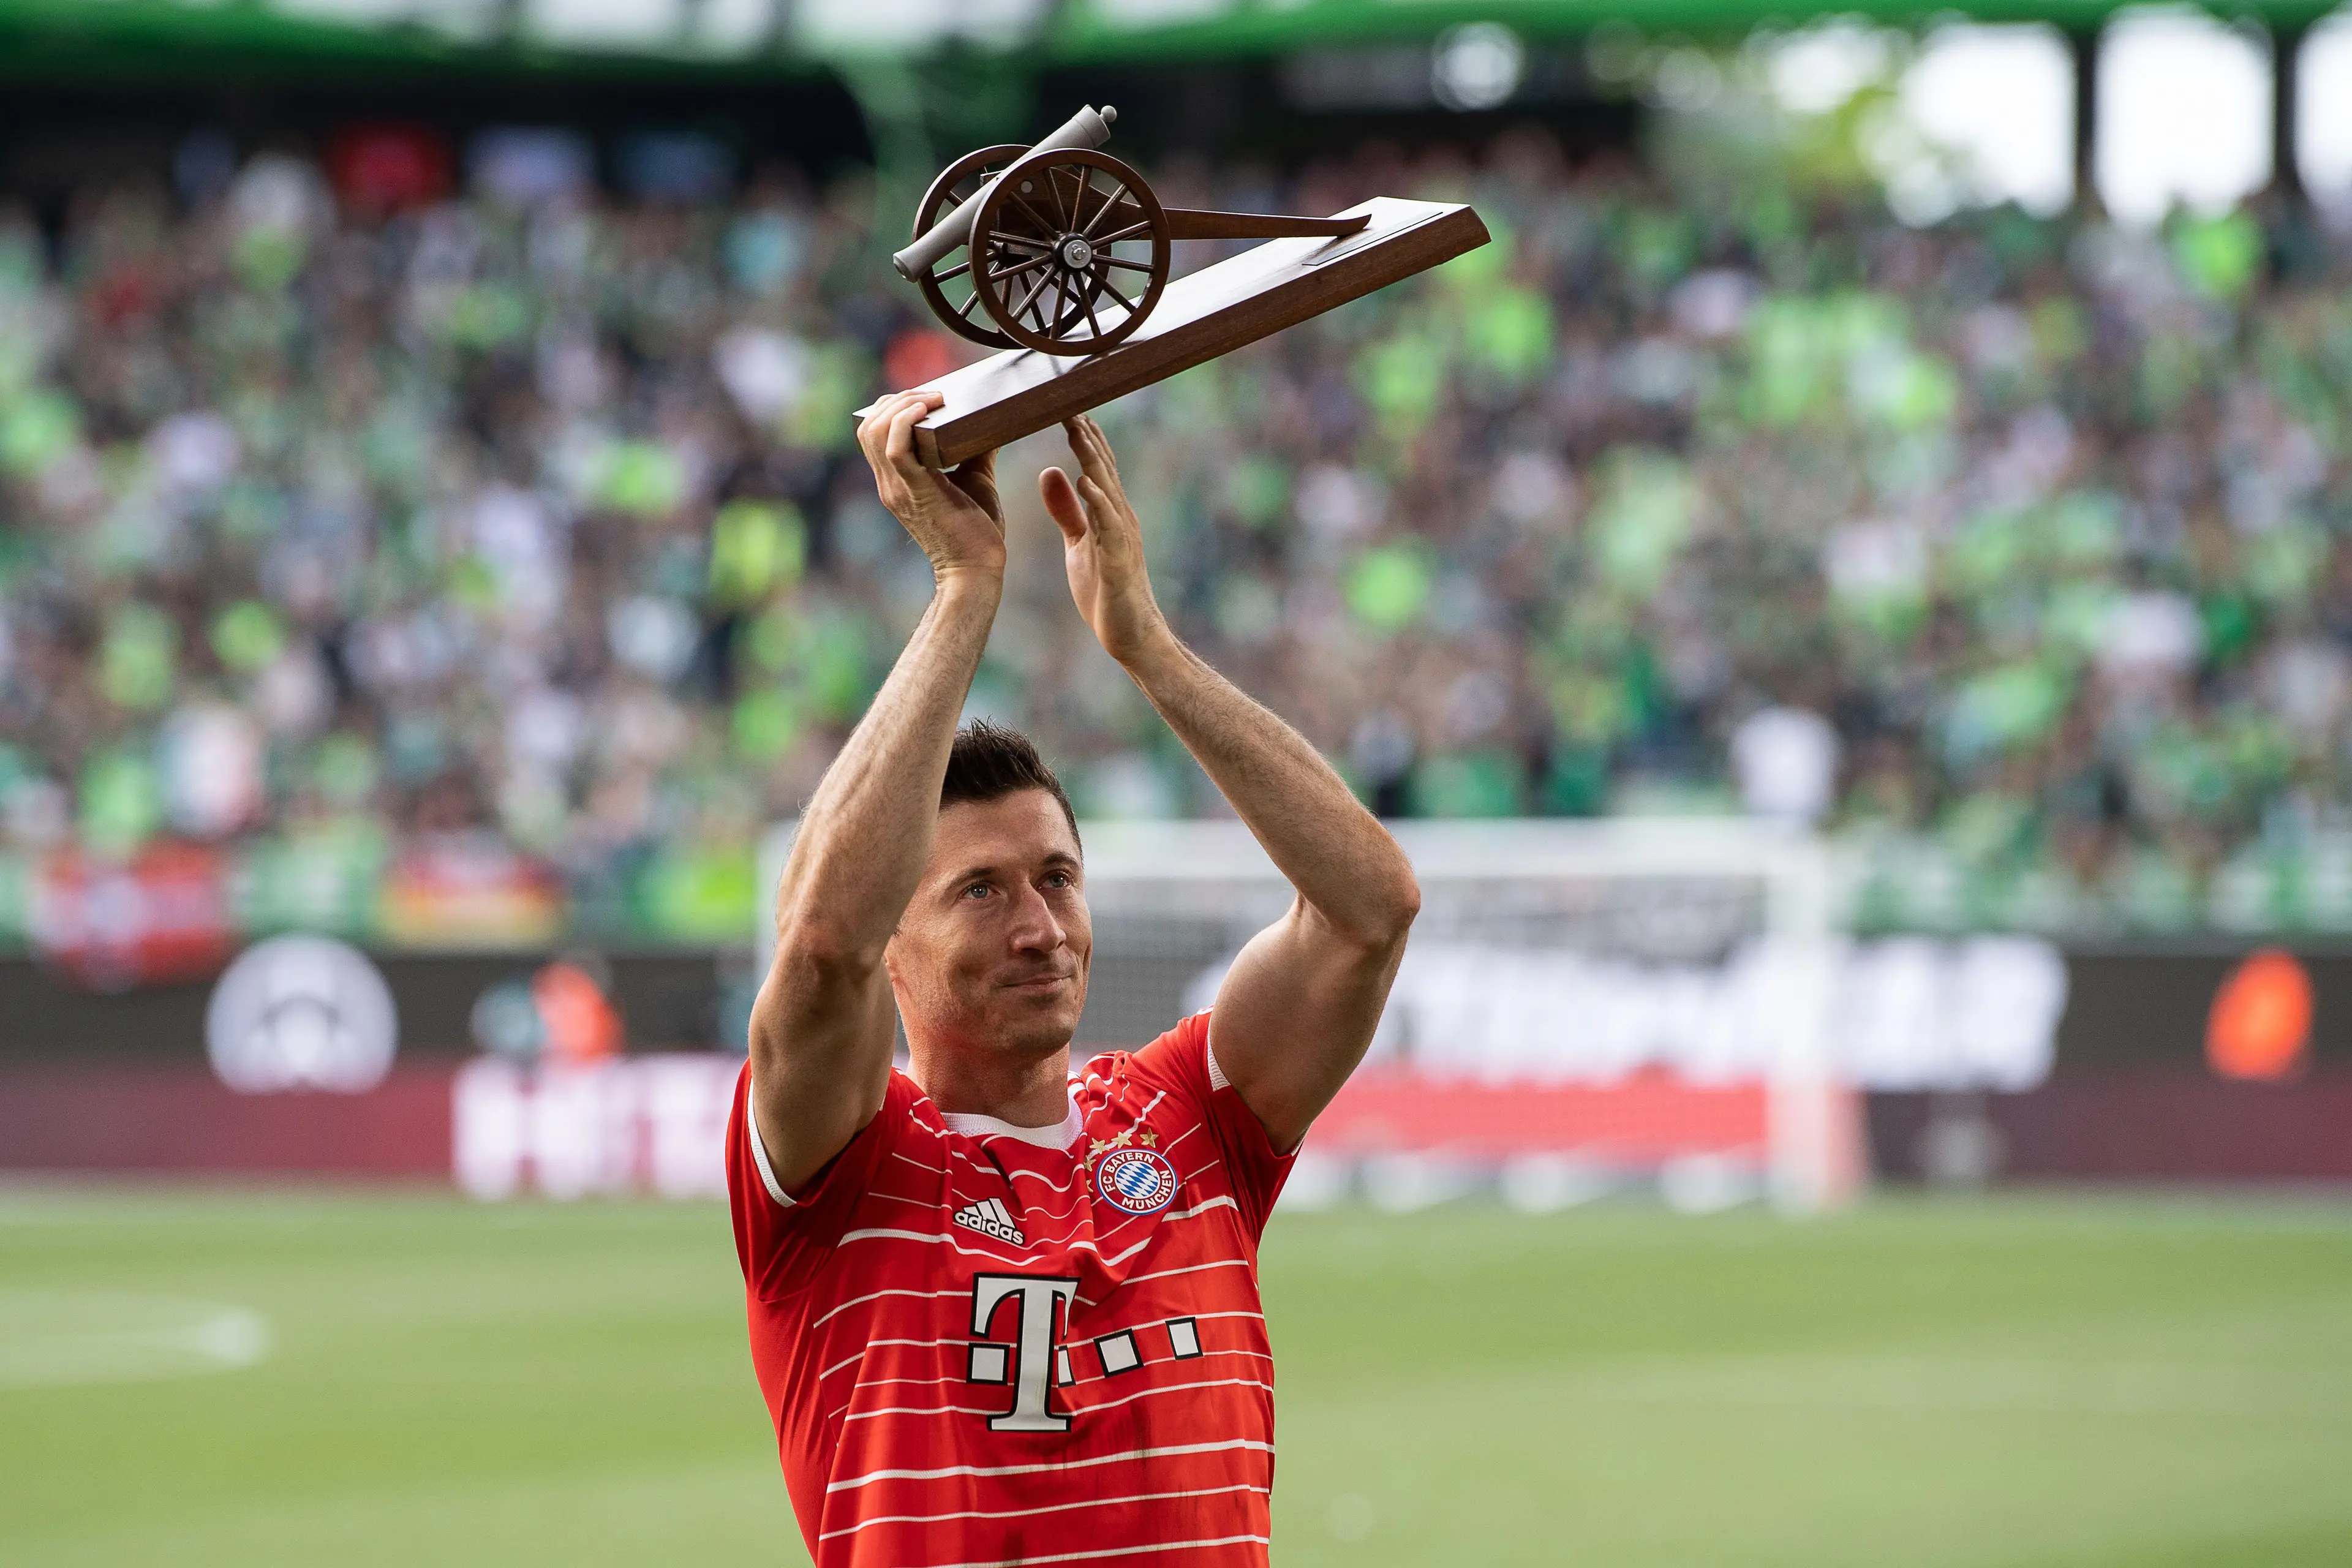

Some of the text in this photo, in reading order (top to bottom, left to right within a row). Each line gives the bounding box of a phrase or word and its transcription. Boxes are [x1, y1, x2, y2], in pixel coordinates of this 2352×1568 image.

[1104, 1152, 1172, 1210] FC BAYERN MÜNCHEN
[954, 1212, 1024, 1245] adidas
[970, 1272, 1081, 1432] T
